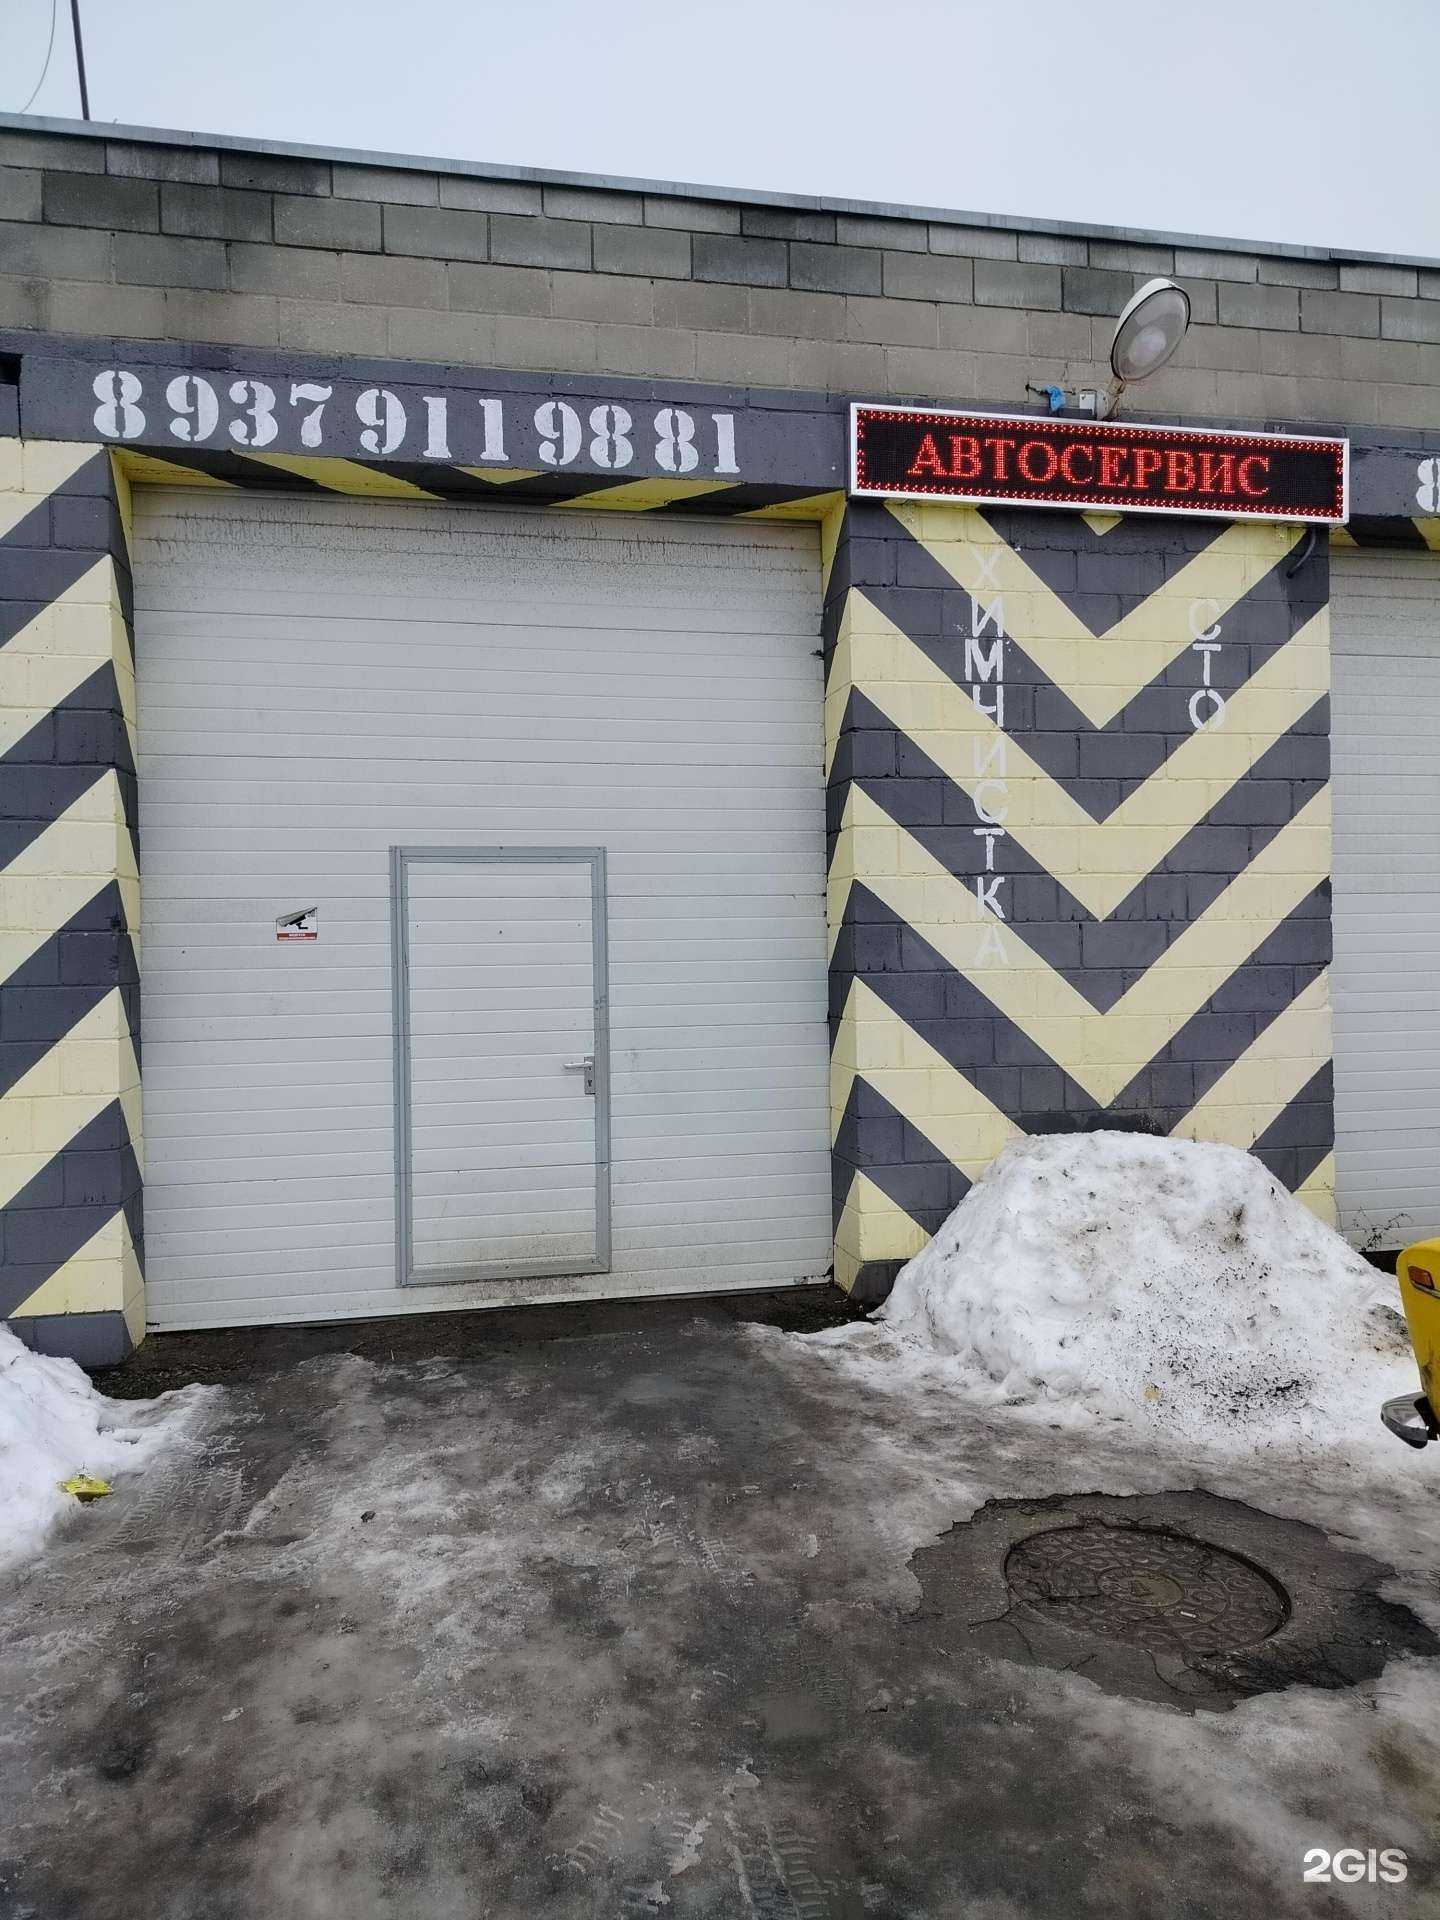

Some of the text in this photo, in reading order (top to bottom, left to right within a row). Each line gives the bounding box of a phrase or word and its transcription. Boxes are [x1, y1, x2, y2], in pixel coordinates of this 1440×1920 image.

[906, 431, 1271, 497] АВТОСЕРВИС
[1188, 598, 1226, 731] СТО
[964, 543, 1009, 968] ХИМЧИСТКА
